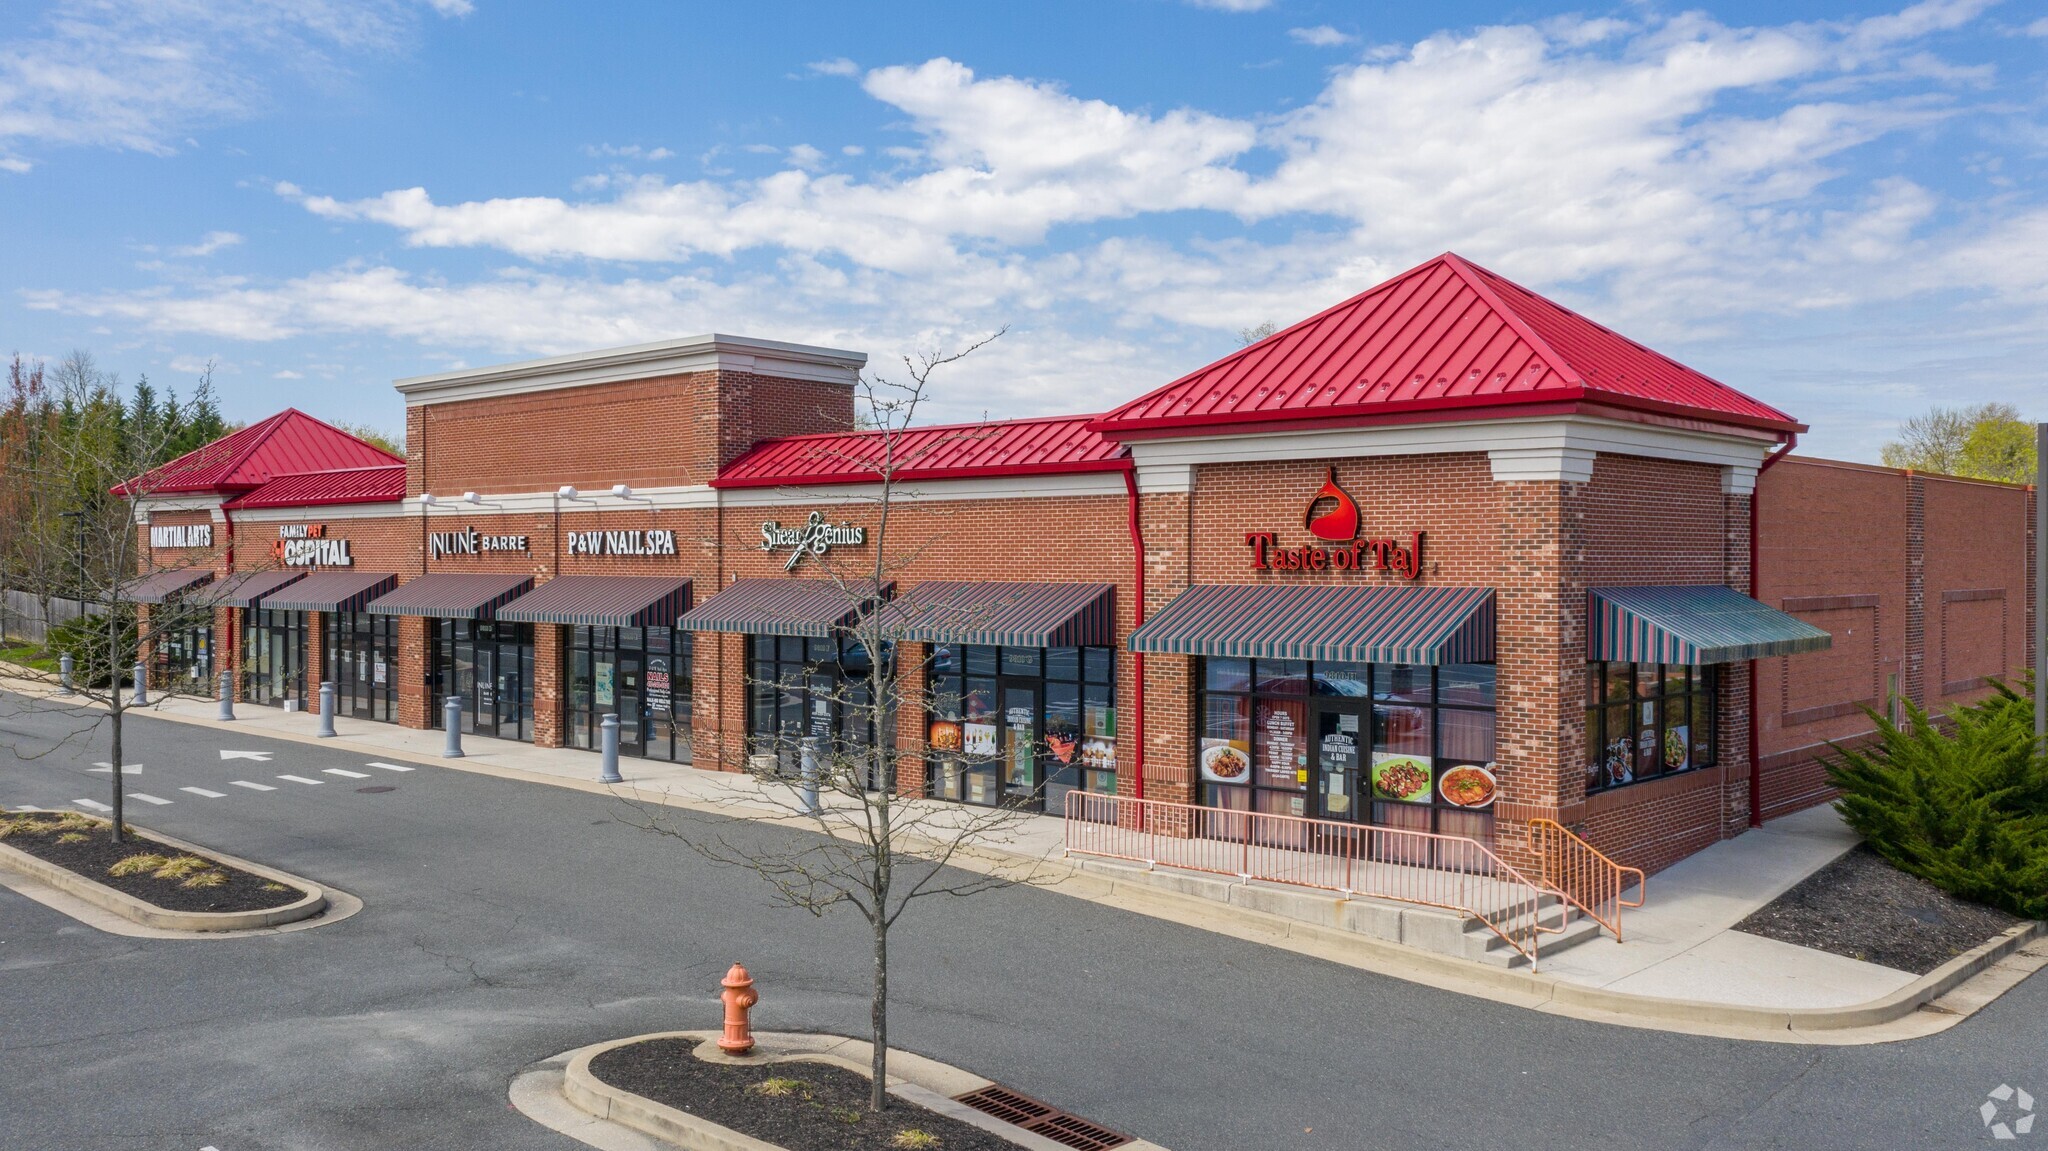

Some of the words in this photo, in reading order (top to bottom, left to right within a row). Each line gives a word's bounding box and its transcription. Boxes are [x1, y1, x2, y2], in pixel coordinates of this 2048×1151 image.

[150, 525, 187, 548] MARTIAL
[187, 524, 211, 547] ARTS
[429, 526, 478, 560] INLINE
[482, 535, 526, 550] BARRE
[568, 531, 604, 555] P&W
[605, 531, 645, 555] NAIL
[646, 530, 675, 555] SPA
[762, 521, 801, 551] Shear
[1245, 532, 1326, 570] Taste
[1333, 539, 1365, 570] of
[646, 671, 669, 683] NAILS
[1322, 743, 1338, 752] INDIAN
[1338, 745, 1356, 754] CUISINE
[1324, 734, 1354, 745] AUTHENTIC
[1330, 753, 1336, 761] &
[1335, 753, 1347, 762] BAR
